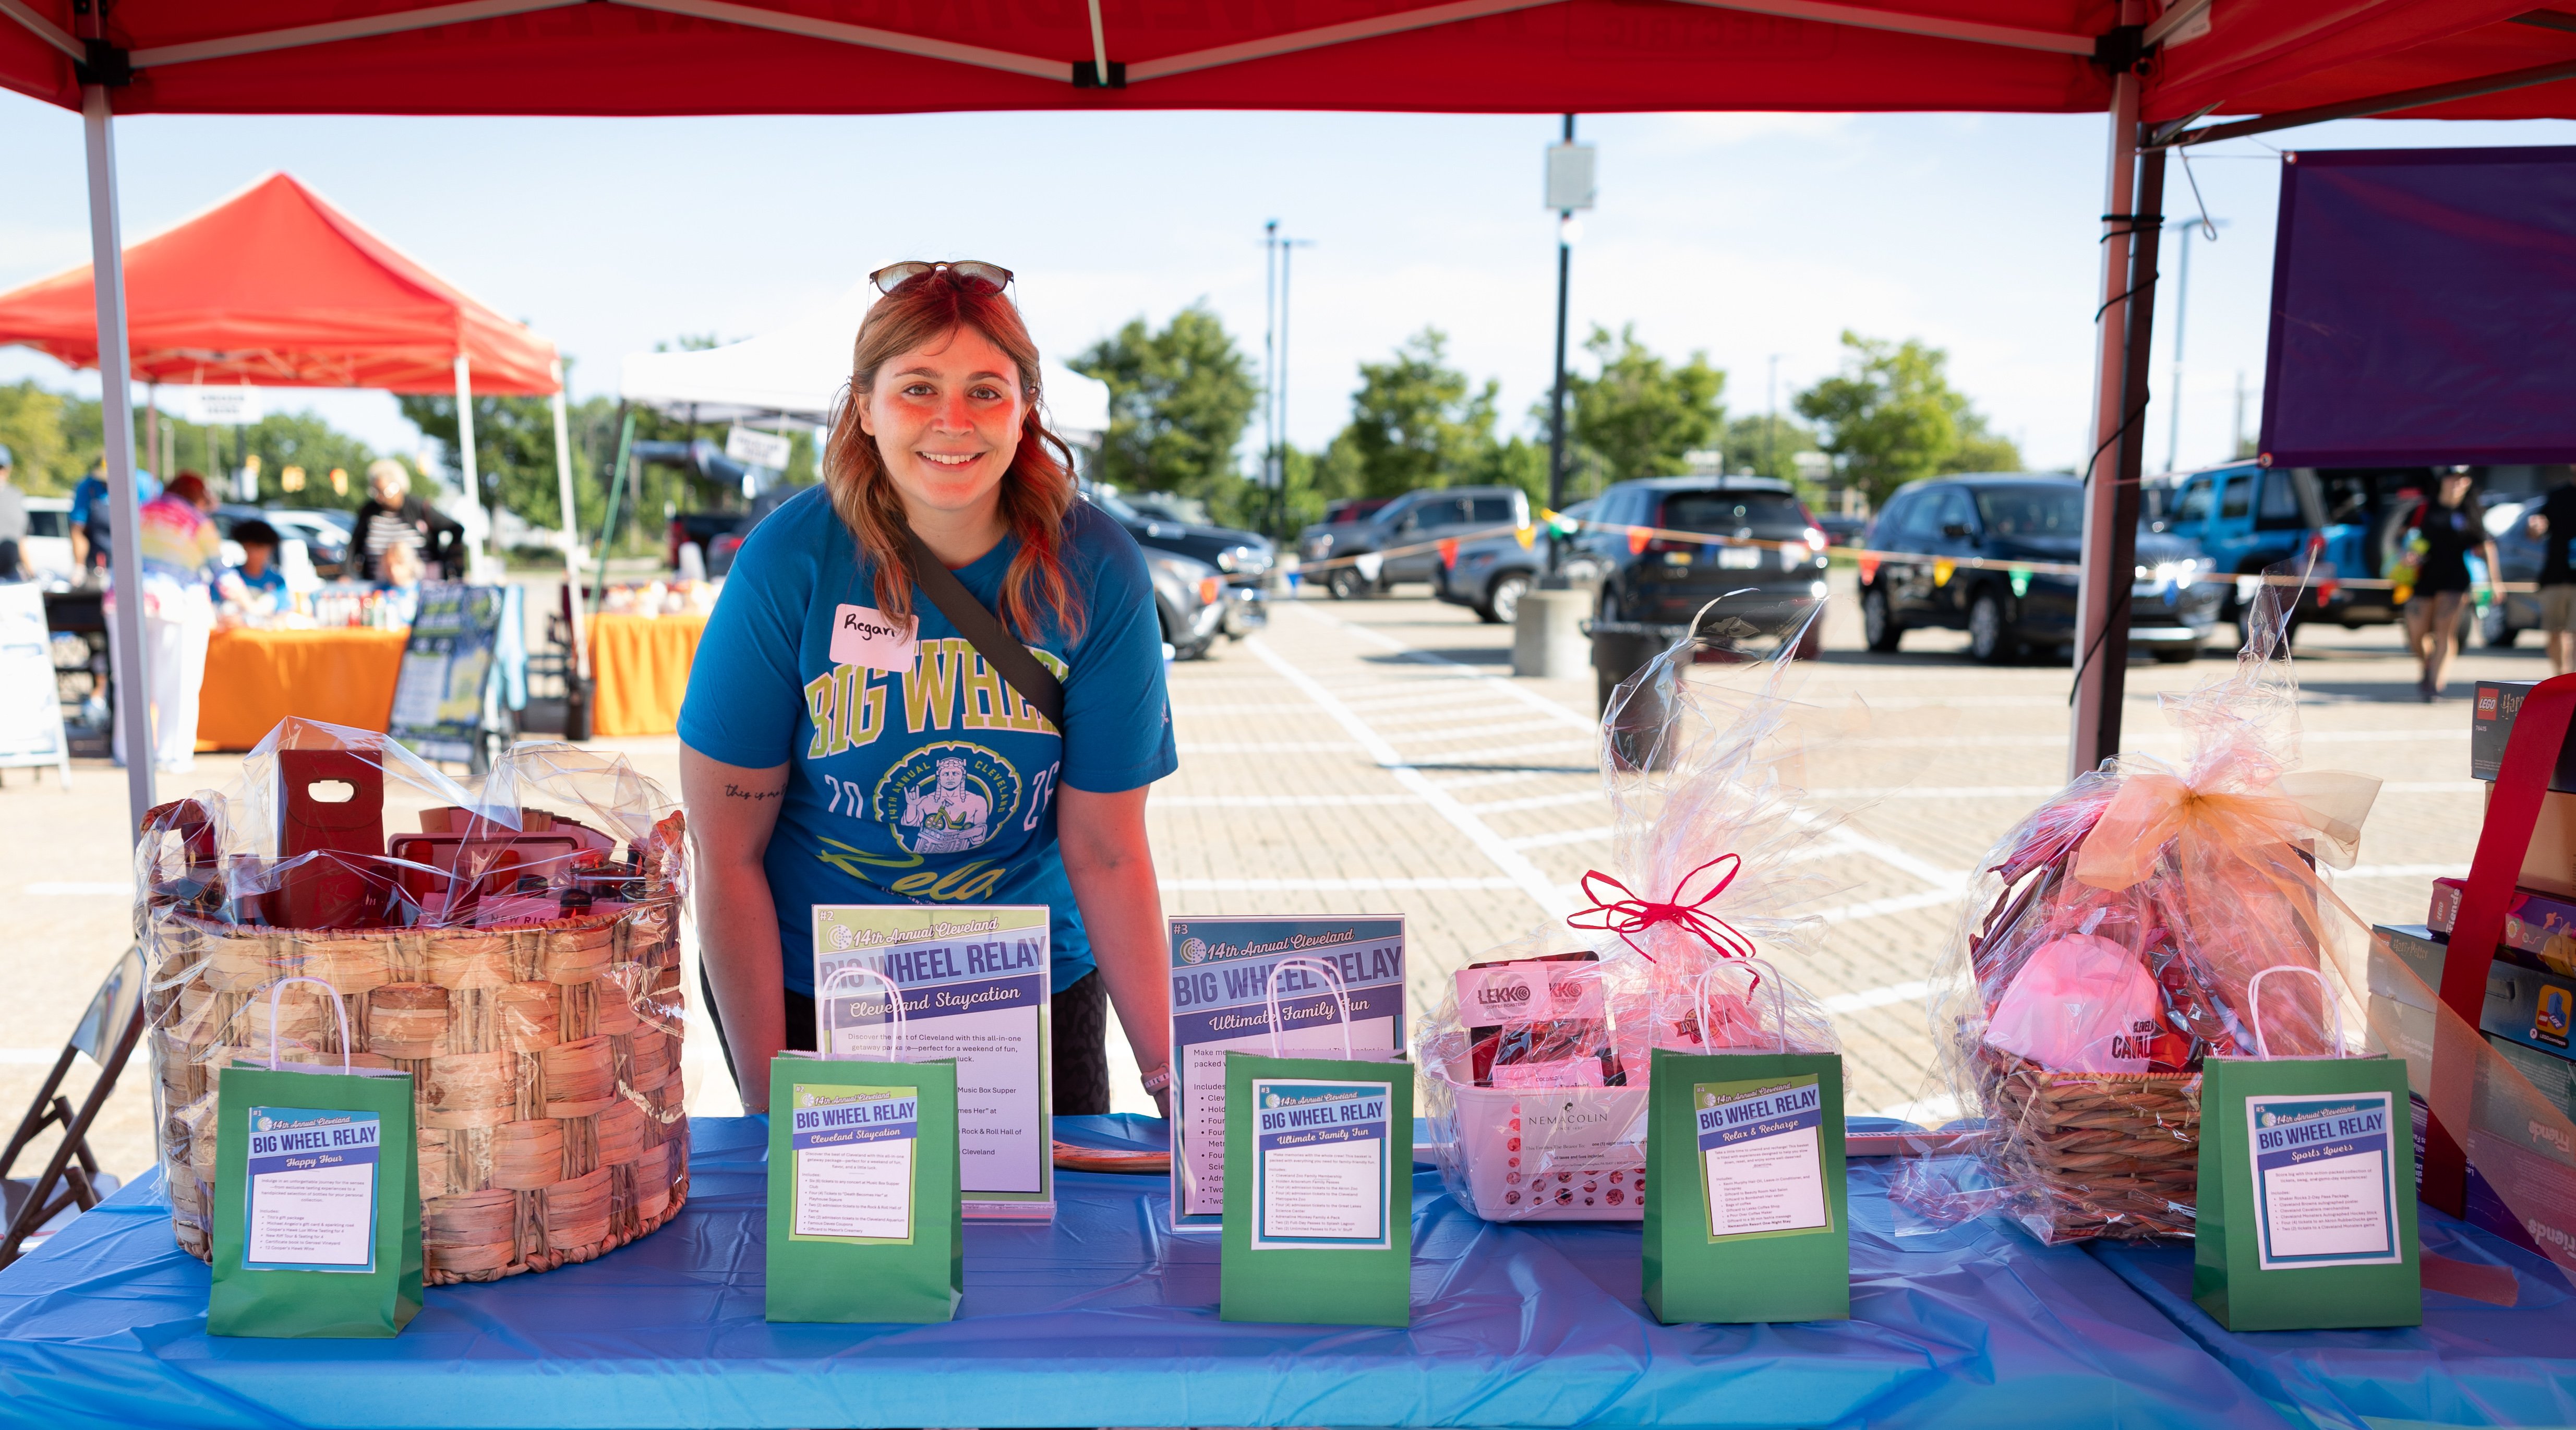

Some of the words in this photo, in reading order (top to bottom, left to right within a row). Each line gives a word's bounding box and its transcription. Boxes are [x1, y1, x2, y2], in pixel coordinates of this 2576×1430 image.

[844, 613, 895, 641] Regan
[804, 663, 888, 760] BIG
[2478, 696, 2496, 711] LEGO
[2500, 693, 2524, 720] Harr
[888, 797, 898, 821] 14TH
[896, 762, 931, 794] ANNUAL
[974, 760, 1009, 813] CLEVELAND
[819, 910, 835, 922] #2
[853, 929, 885, 948] 14th
[885, 924, 935, 945] Annual
[935, 917, 1000, 938] Cleveland
[1173, 923, 1189, 935] #3
[1207, 941, 1239, 960] 14th
[1239, 938, 1290, 957] Annual
[1290, 928, 1355, 950] Cleveland
[819, 958, 864, 992] BIG
[869, 947, 962, 986] WHEEL
[966, 936, 1047, 974] RELAY
[1172, 972, 1218, 1007] BIG
[1223, 960, 1317, 1000] WHEEL
[1325, 945, 1402, 984] RELAY
[849, 994, 931, 1018] Cleveland
[935, 986, 1021, 1011] Staycation
[1208, 1013, 1277, 1032] Ultimate
[1281, 1001, 1336, 1022] Family
[2133, 1018, 2154, 1033] CLEVEL
[2549, 1015, 2563, 1029] LIFE
[814, 1096, 832, 1106] 14th
[832, 1095, 857, 1104] Annual
[856, 1091, 891, 1102] Cleveland
[1280, 1096, 1297, 1107] 14th
[1298, 1095, 1323, 1104] Annual
[1323, 1091, 1358, 1102] Cleveland
[1716, 1095, 1732, 1105] 14th
[1733, 1090, 1758, 1101] Annual
[1758, 1081, 1791, 1096] Cleveland
[796, 1111, 820, 1129] BIG
[822, 1107, 870, 1126] WHEEL
[873, 1102, 915, 1121] RELAY
[1262, 1112, 1285, 1130] BIG
[1288, 1107, 1338, 1127] WHEEL
[1340, 1101, 1383, 1122] RELAY
[1529, 1113, 1607, 1125] NEMACOLIN
[1700, 1110, 1723, 1130] BIG
[1725, 1100, 1774, 1124] WHEEL
[1775, 1089, 1816, 1113] RELAY
[2276, 1114, 2293, 1124] 14th
[2294, 1110, 2320, 1122] Annual
[2320, 1104, 2356, 1117] Cleveland
[272, 1120, 290, 1129] 14th
[291, 1119, 316, 1128] Annual
[316, 1115, 352, 1126] Cleveland
[1723, 1130, 1749, 1142] Relax
[1750, 1127, 1757, 1136] &
[1759, 1119, 1800, 1134] Recharge
[2259, 1130, 2283, 1149] BIG
[2285, 1122, 2336, 1144] WHEEL
[2339, 1113, 2382, 1135] RELAY
[253, 1136, 277, 1153] BIG
[281, 1131, 330, 1151] WHEEL
[333, 1126, 377, 1146] RELAY
[811, 1131, 853, 1144] Cleveland
[856, 1128, 901, 1141] Staycation
[1277, 1134, 1317, 1145] Ultimate
[1319, 1129, 1350, 1140] Family
[1352, 1127, 1369, 1137] Fun
[286, 1158, 317, 1169] Happy
[319, 1154, 343, 1164] Hour
[2292, 1148, 2321, 1162] Sports
[2323, 1144, 2354, 1156] Lovers
